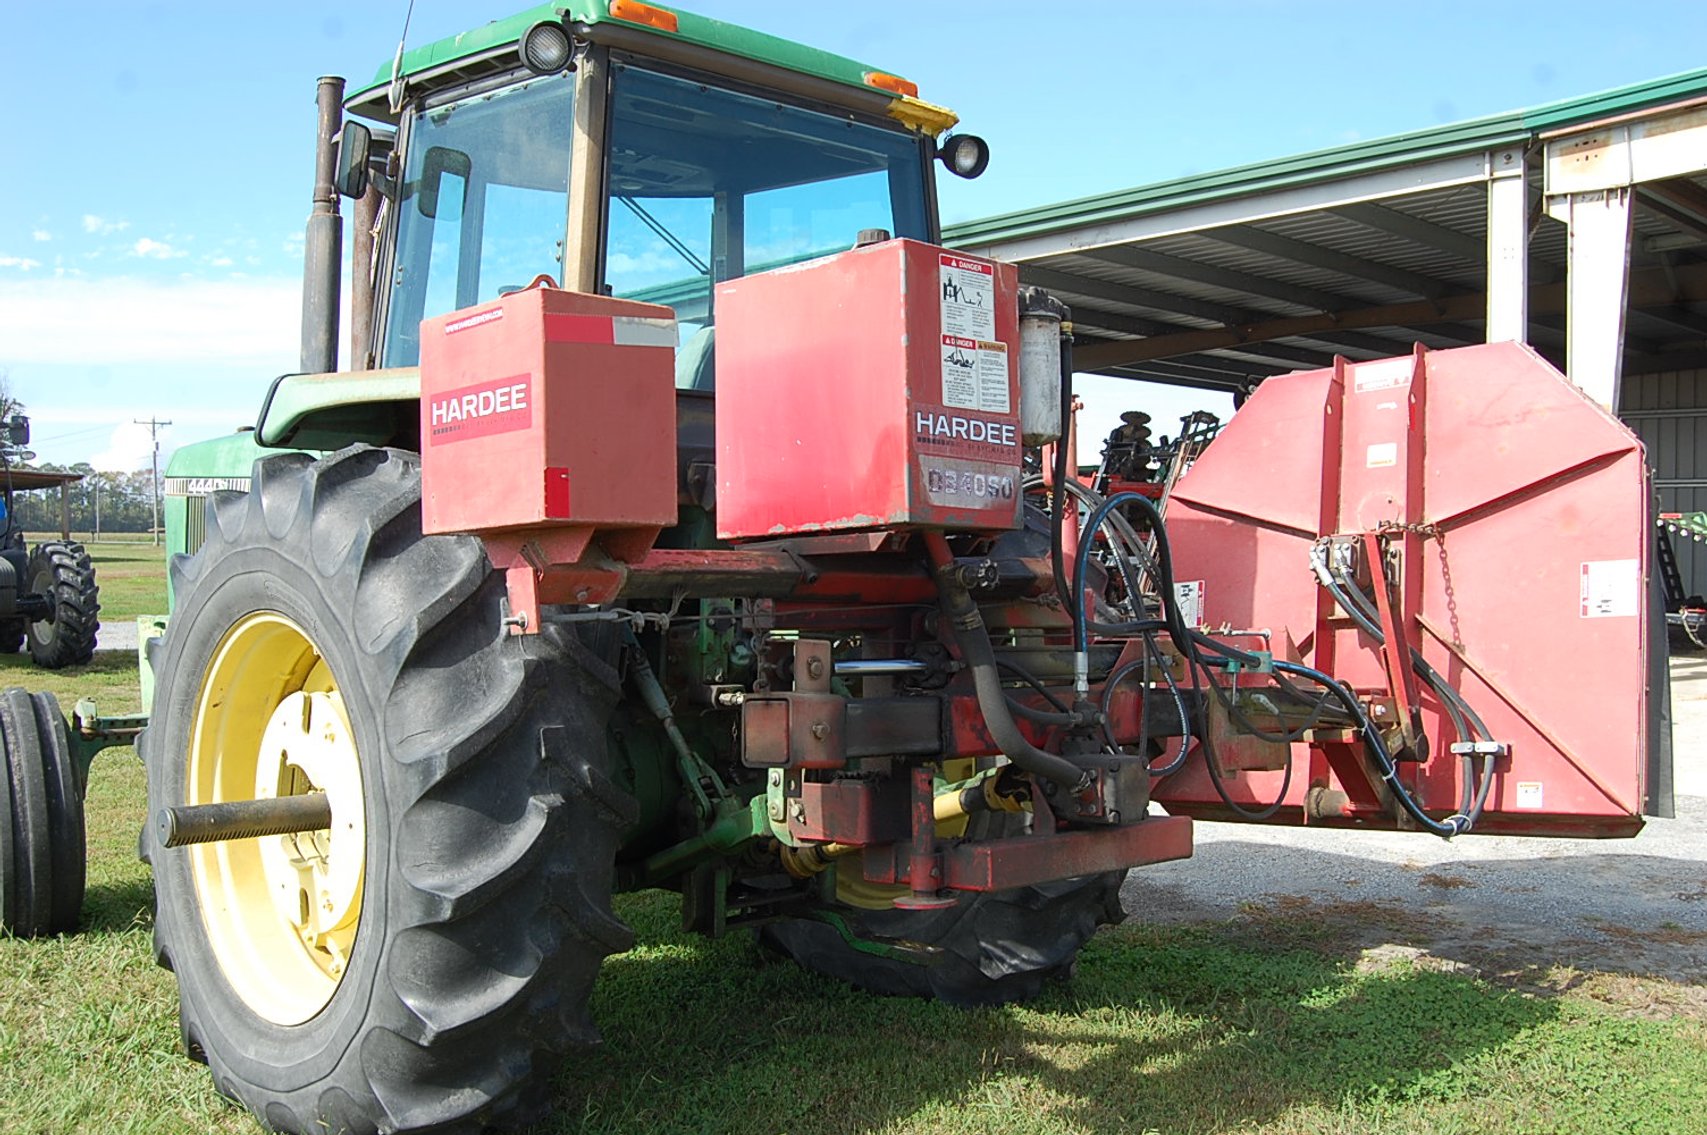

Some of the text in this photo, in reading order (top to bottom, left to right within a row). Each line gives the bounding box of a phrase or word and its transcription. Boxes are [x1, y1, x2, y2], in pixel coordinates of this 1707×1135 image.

[958, 260, 982, 272] DANGER
[431, 383, 527, 426] HARDEE
[916, 411, 1016, 446] HARDEE
